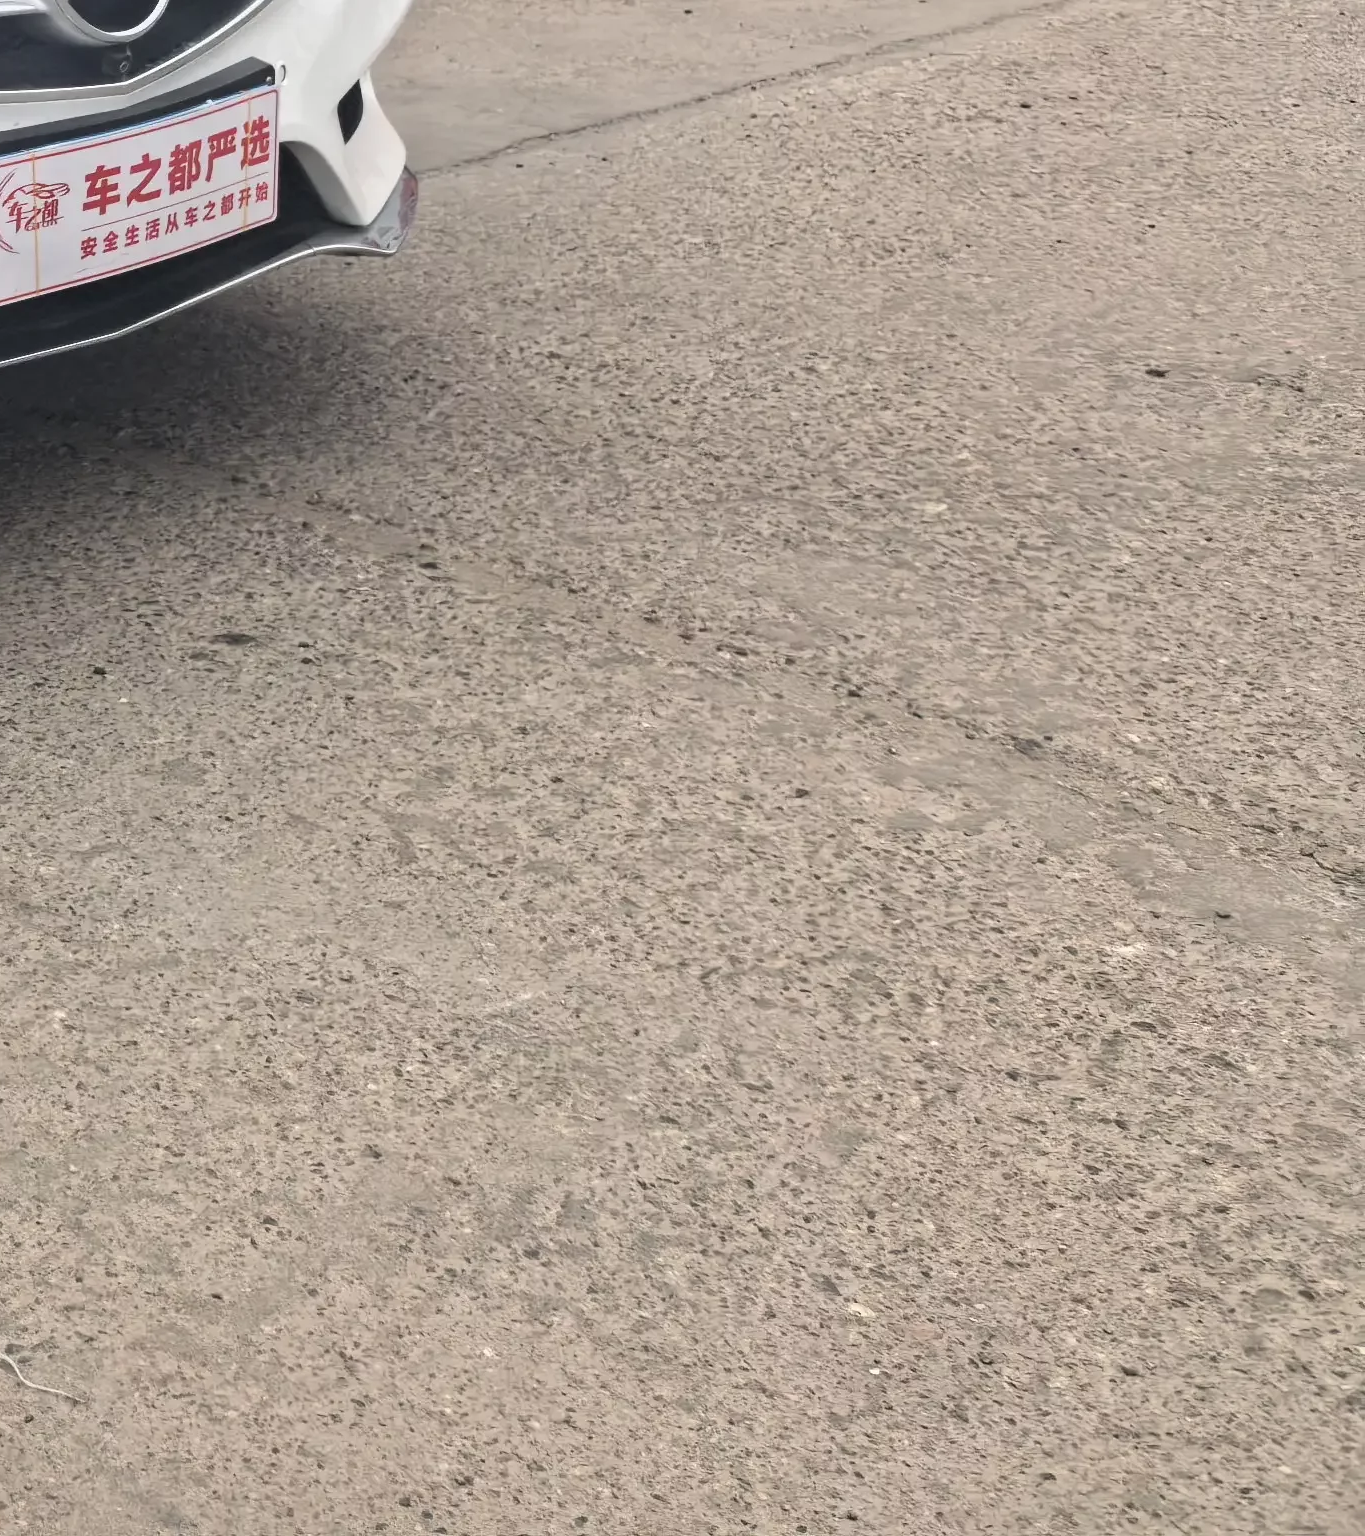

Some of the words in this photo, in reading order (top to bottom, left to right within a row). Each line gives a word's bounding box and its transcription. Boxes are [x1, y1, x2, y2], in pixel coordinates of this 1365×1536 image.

[83, 115, 270, 215] 车之都严选
[80, 182, 269, 259] 安全生活从车之都开始
